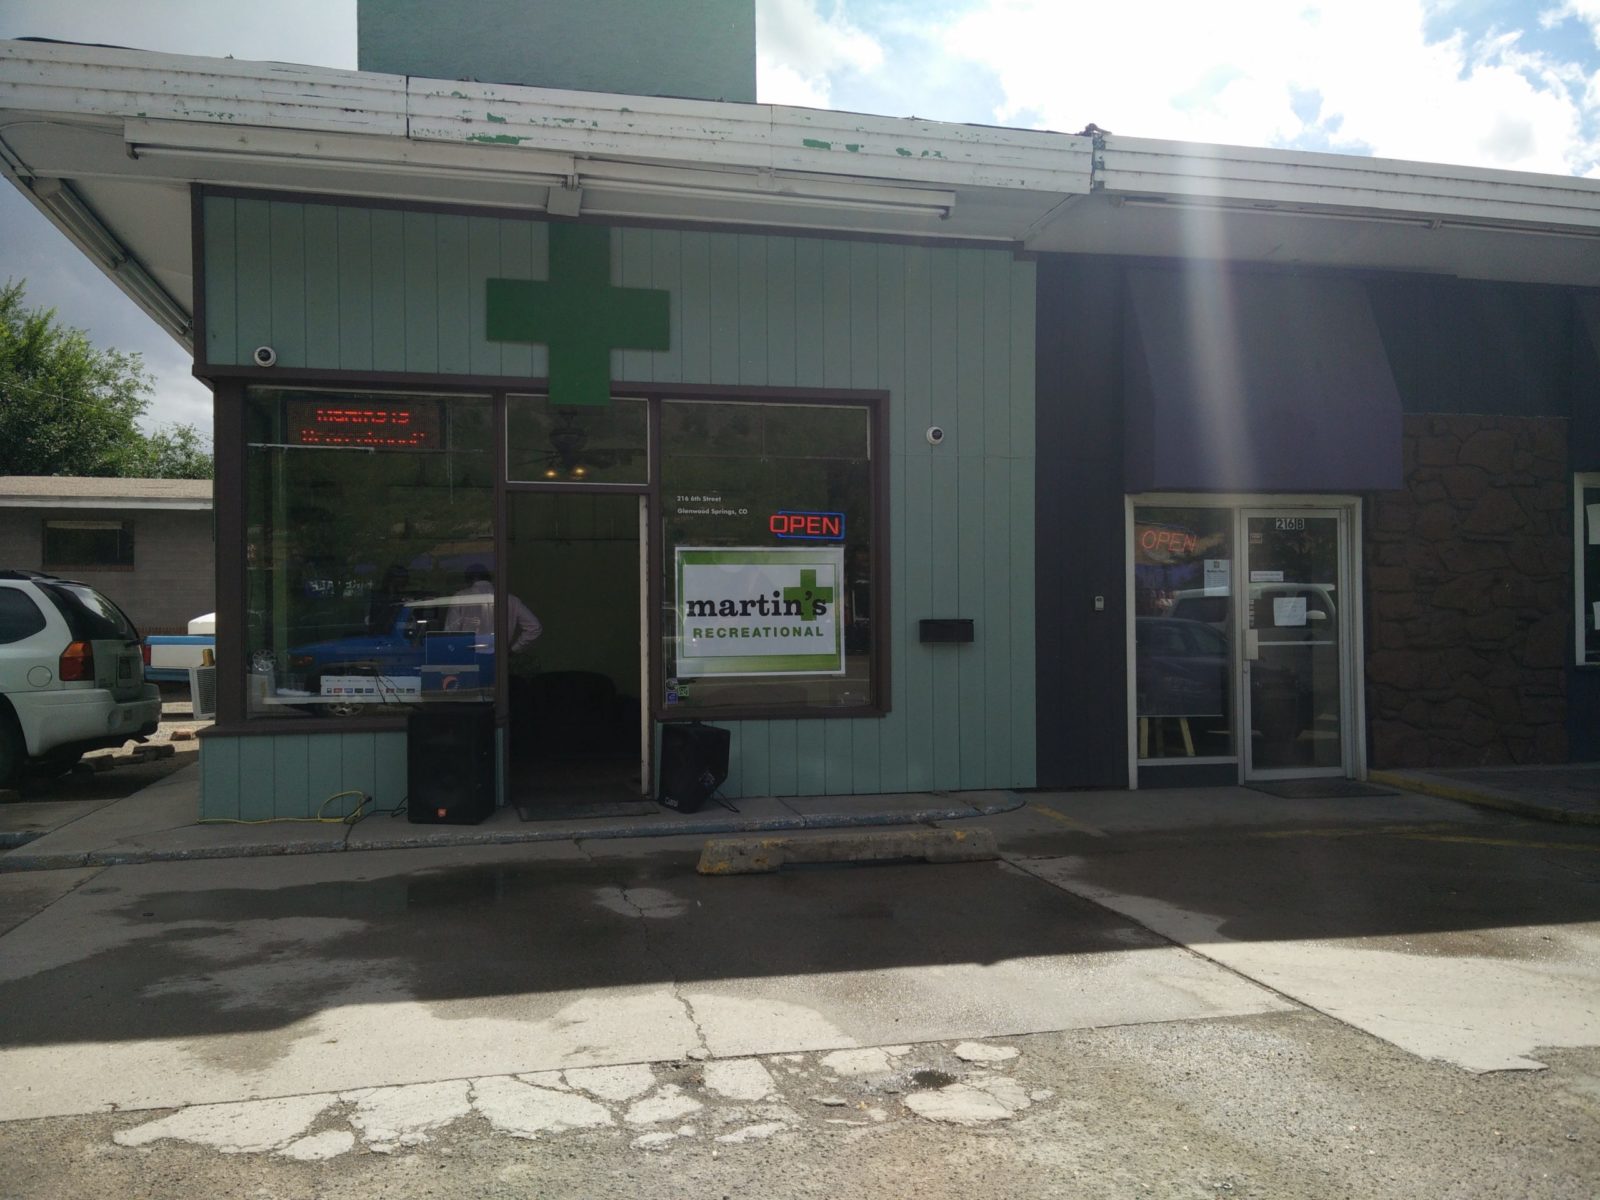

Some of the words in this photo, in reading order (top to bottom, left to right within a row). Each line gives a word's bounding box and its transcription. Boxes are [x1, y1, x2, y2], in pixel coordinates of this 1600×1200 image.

[677, 507, 710, 515] Glenwood
[711, 507, 737, 516] Springs,
[769, 514, 840, 535] OPEN
[1142, 530, 1197, 553] OPEN
[686, 590, 828, 617] martin's
[693, 626, 824, 639] RECREATIONAL
